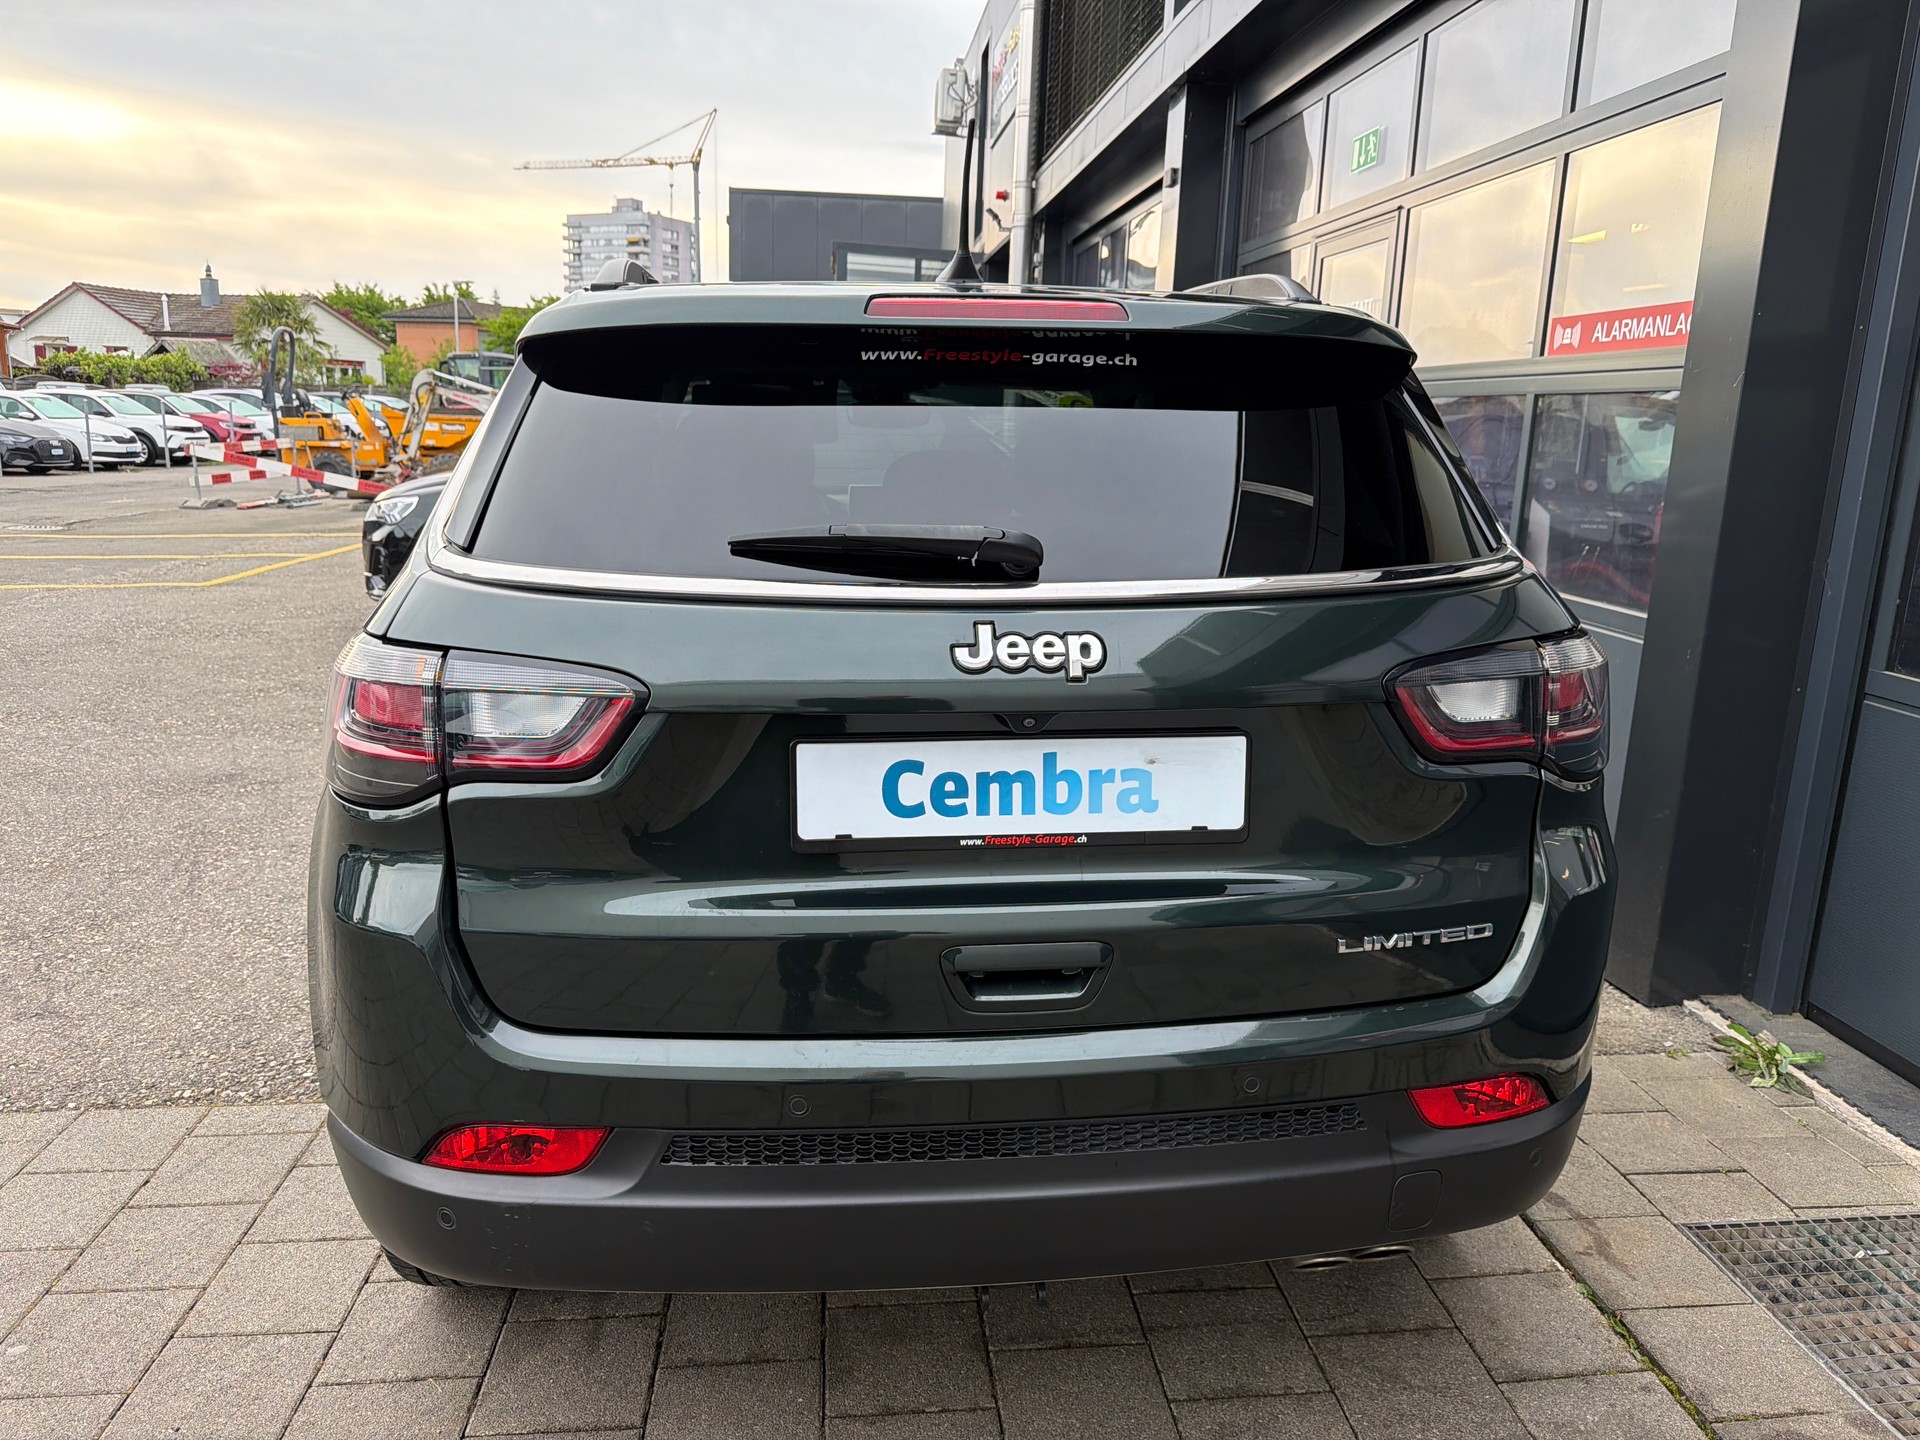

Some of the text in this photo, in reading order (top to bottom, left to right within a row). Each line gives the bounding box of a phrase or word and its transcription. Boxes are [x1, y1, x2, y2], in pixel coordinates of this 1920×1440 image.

[861, 348, 1137, 367] www.Freestyle-garage.ch
[951, 621, 1105, 681] Jeep
[882, 751, 1159, 818] Cembra
[960, 834, 1087, 846] www.Freestyle-Garage.ch
[1337, 923, 1494, 953] LIMITED
